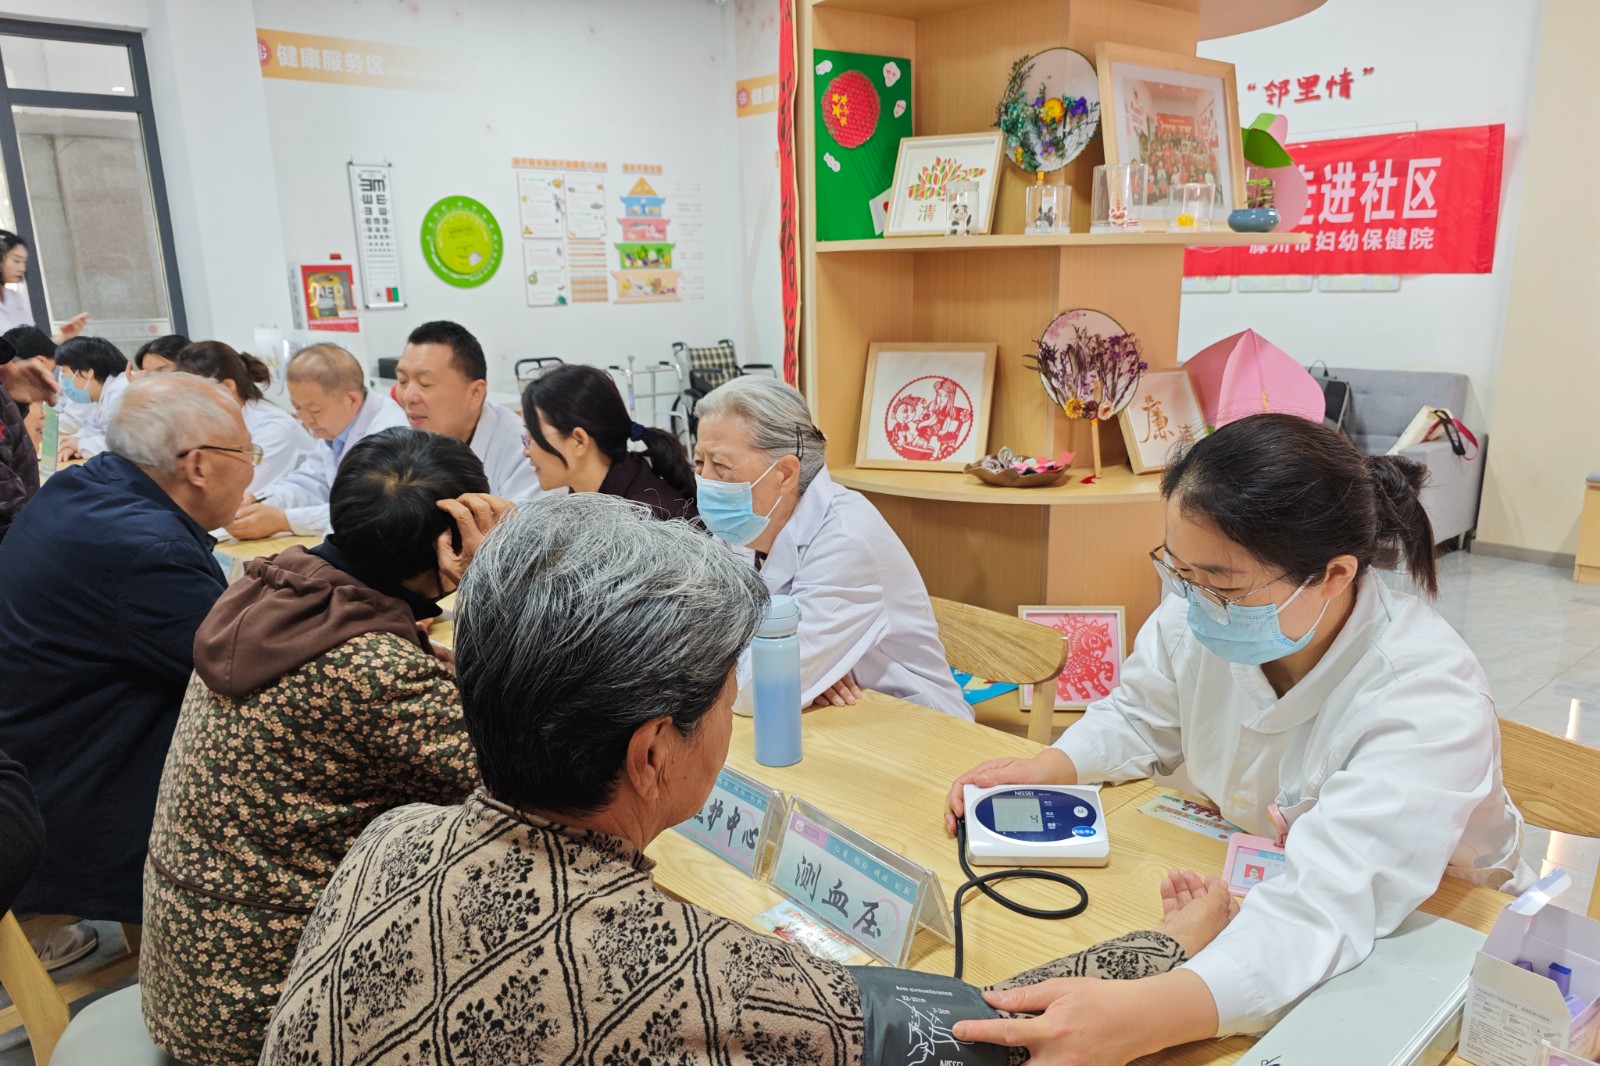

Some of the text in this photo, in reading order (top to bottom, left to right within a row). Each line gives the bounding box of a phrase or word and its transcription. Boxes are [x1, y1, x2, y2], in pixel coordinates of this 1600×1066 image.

[276, 43, 386, 77] 健康服务区
[794, 851, 882, 940] 测血压
